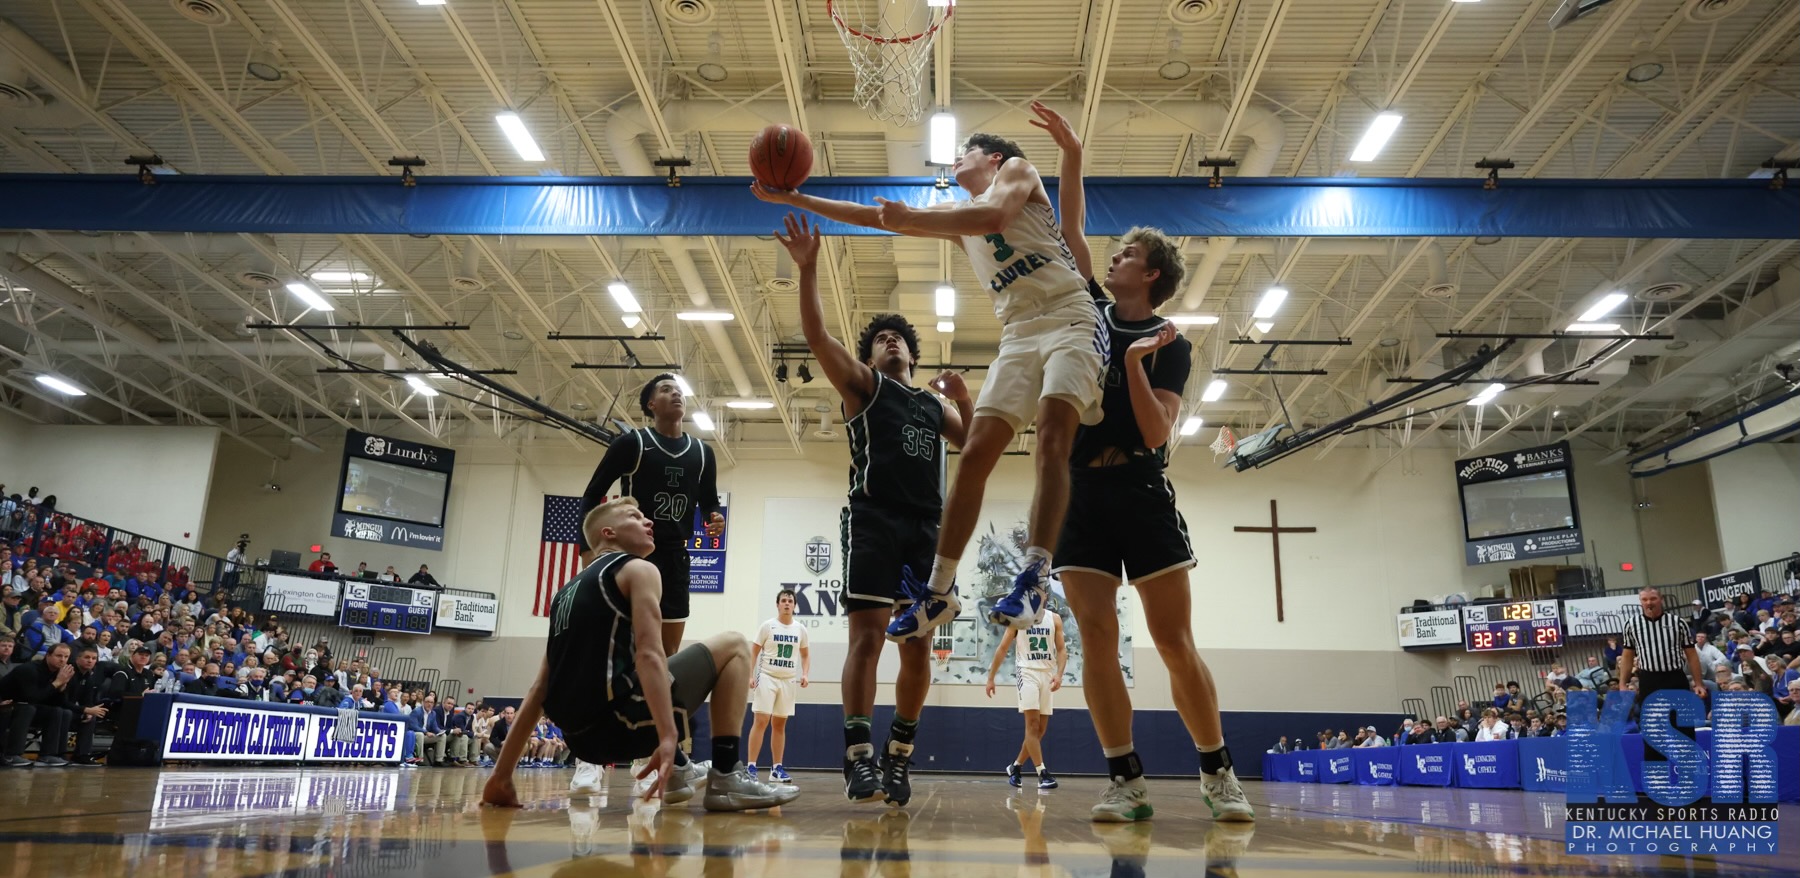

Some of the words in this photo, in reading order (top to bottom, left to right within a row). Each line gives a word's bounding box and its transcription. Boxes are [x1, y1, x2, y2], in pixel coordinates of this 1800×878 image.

[984, 233, 1014, 262] 3
[902, 424, 936, 461] 35
[387, 442, 438, 465] Lundy's
[1526, 448, 1564, 461] BANKS
[1459, 457, 1509, 478] TACO-TICO
[1516, 460, 1547, 469] VETERINARY
[664, 466, 684, 487] T
[653, 491, 688, 522] 20
[419, 533, 435, 541] lovin'
[1538, 534, 1560, 542] TRIPLE
[1487, 542, 1516, 556] MINGUA
[819, 580, 840, 588] HO
[1721, 576, 1736, 585] THE
[278, 588, 314, 598] Lexington
[316, 592, 336, 600] Clinic
[347, 585, 365, 599] LC
[1707, 580, 1755, 603] DUNGEON
[349, 600, 368, 609] HOME
[408, 607, 429, 615] GUEST
[455, 600, 496, 614] Traditional
[1537, 604, 1555, 617] LC
[455, 612, 474, 623] Bank
[1467, 609, 1484, 622] LC
[1503, 604, 1531, 620] 1:22
[1414, 614, 1458, 627] Traditional
[1532, 619, 1555, 628] GUEST
[1026, 627, 1050, 635] NORTH
[1416, 628, 1437, 638] Bank
[1537, 628, 1557, 644] 29
[773, 634, 799, 643] NORTH
[1029, 636, 1048, 651] 24
[1474, 632, 1492, 648] 32
[1508, 632, 1516, 644] 2
[777, 643, 793, 659] 10
[769, 658, 795, 669] LAUREL
[169, 707, 250, 755] LEXINGTON
[250, 713, 306, 756] CATHOLIC
